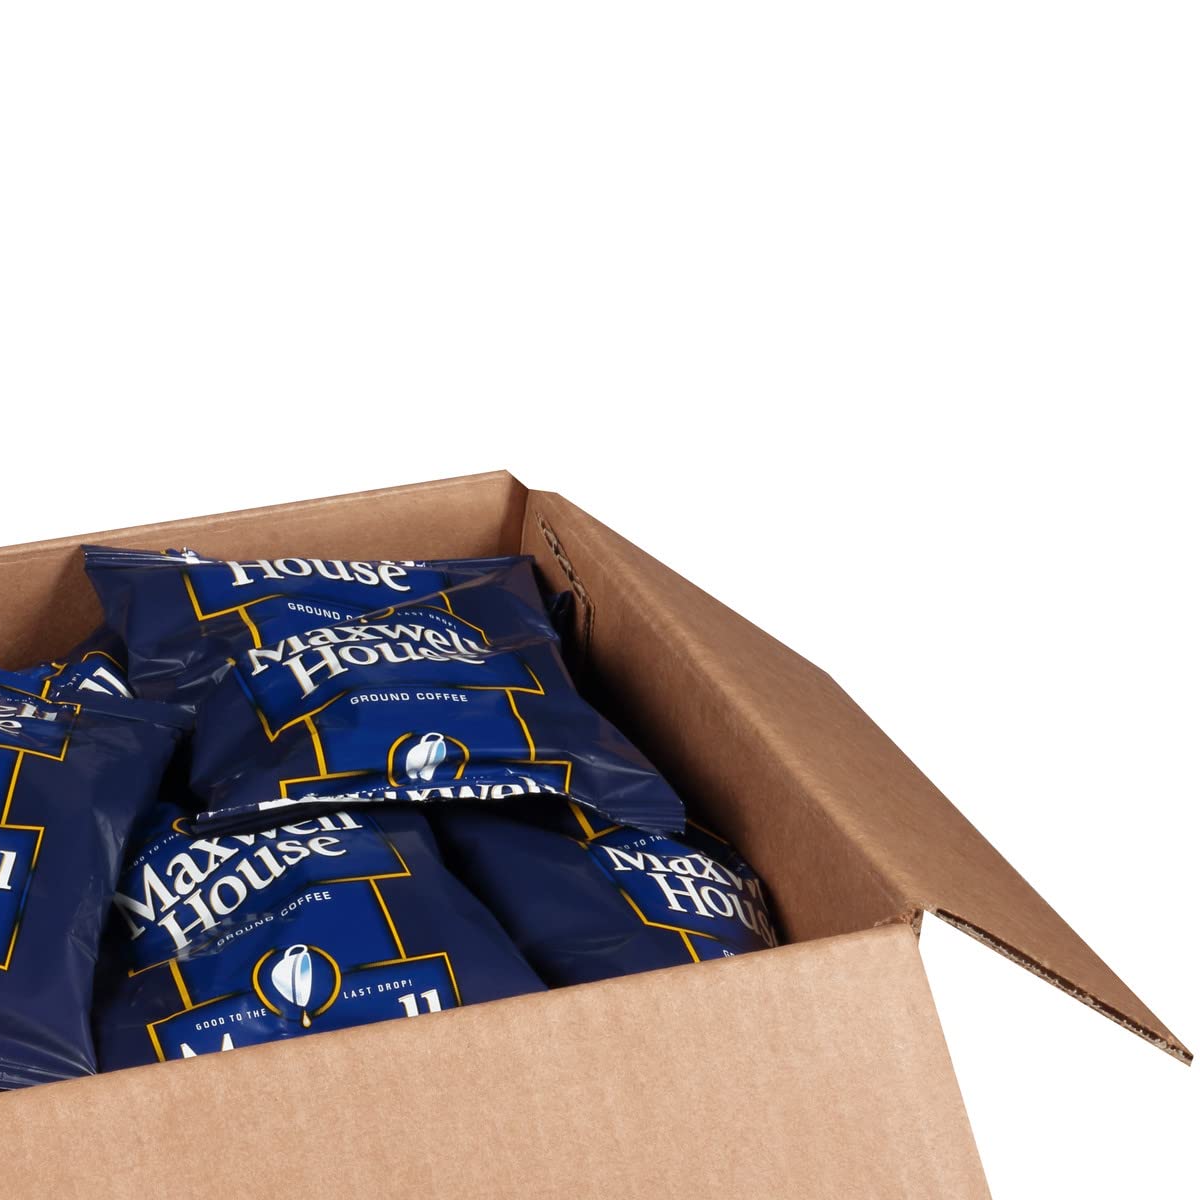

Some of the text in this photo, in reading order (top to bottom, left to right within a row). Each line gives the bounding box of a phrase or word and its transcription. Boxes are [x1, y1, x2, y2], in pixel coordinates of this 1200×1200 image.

[287, 602, 341, 620] GROUND
[350, 692, 468, 705] GROUND COFFEE
[158, 836, 347, 952] House
[216, 891, 332, 947] GROUND COFFEE
[343, 979, 413, 999] LAST DROP!
[195, 1008, 267, 1031] GOOD TO THE
